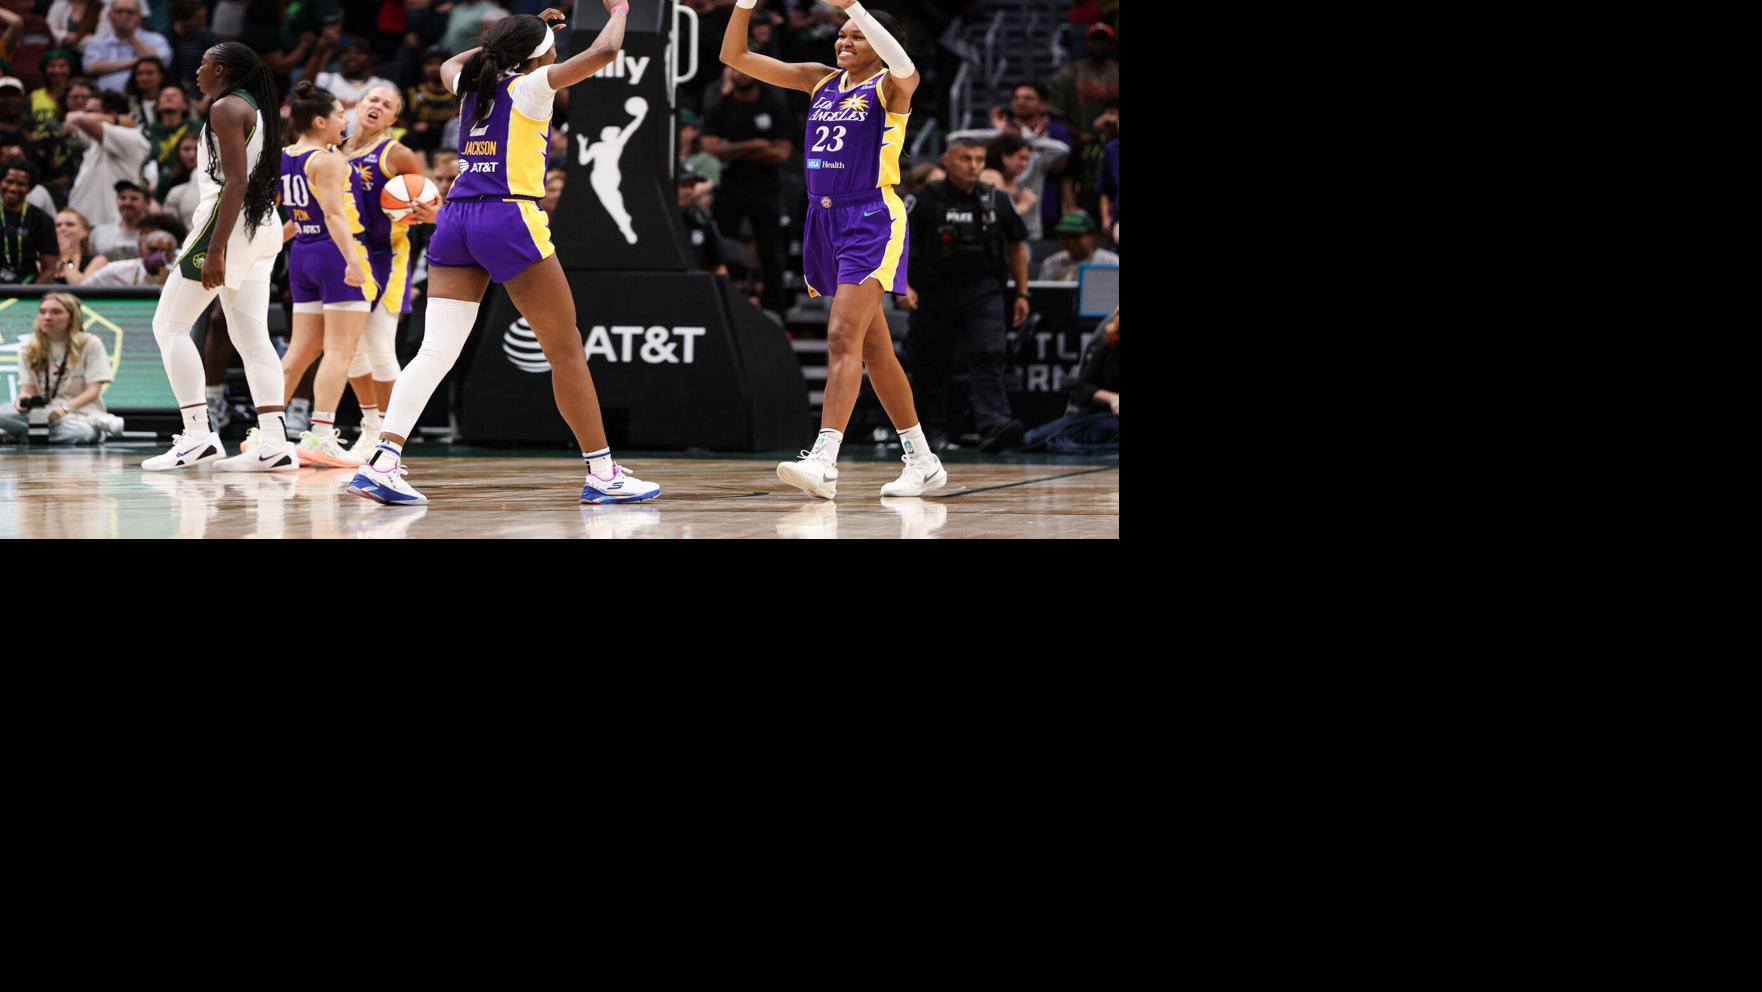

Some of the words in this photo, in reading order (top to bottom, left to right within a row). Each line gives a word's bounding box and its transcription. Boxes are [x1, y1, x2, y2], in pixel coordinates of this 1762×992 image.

[595, 49, 650, 85] lly
[461, 141, 497, 156] JACKSON
[811, 125, 847, 152] 23
[470, 162, 499, 173] AT&T
[822, 160, 845, 169] Health
[280, 173, 309, 207] 10
[584, 325, 706, 364] AT&T
